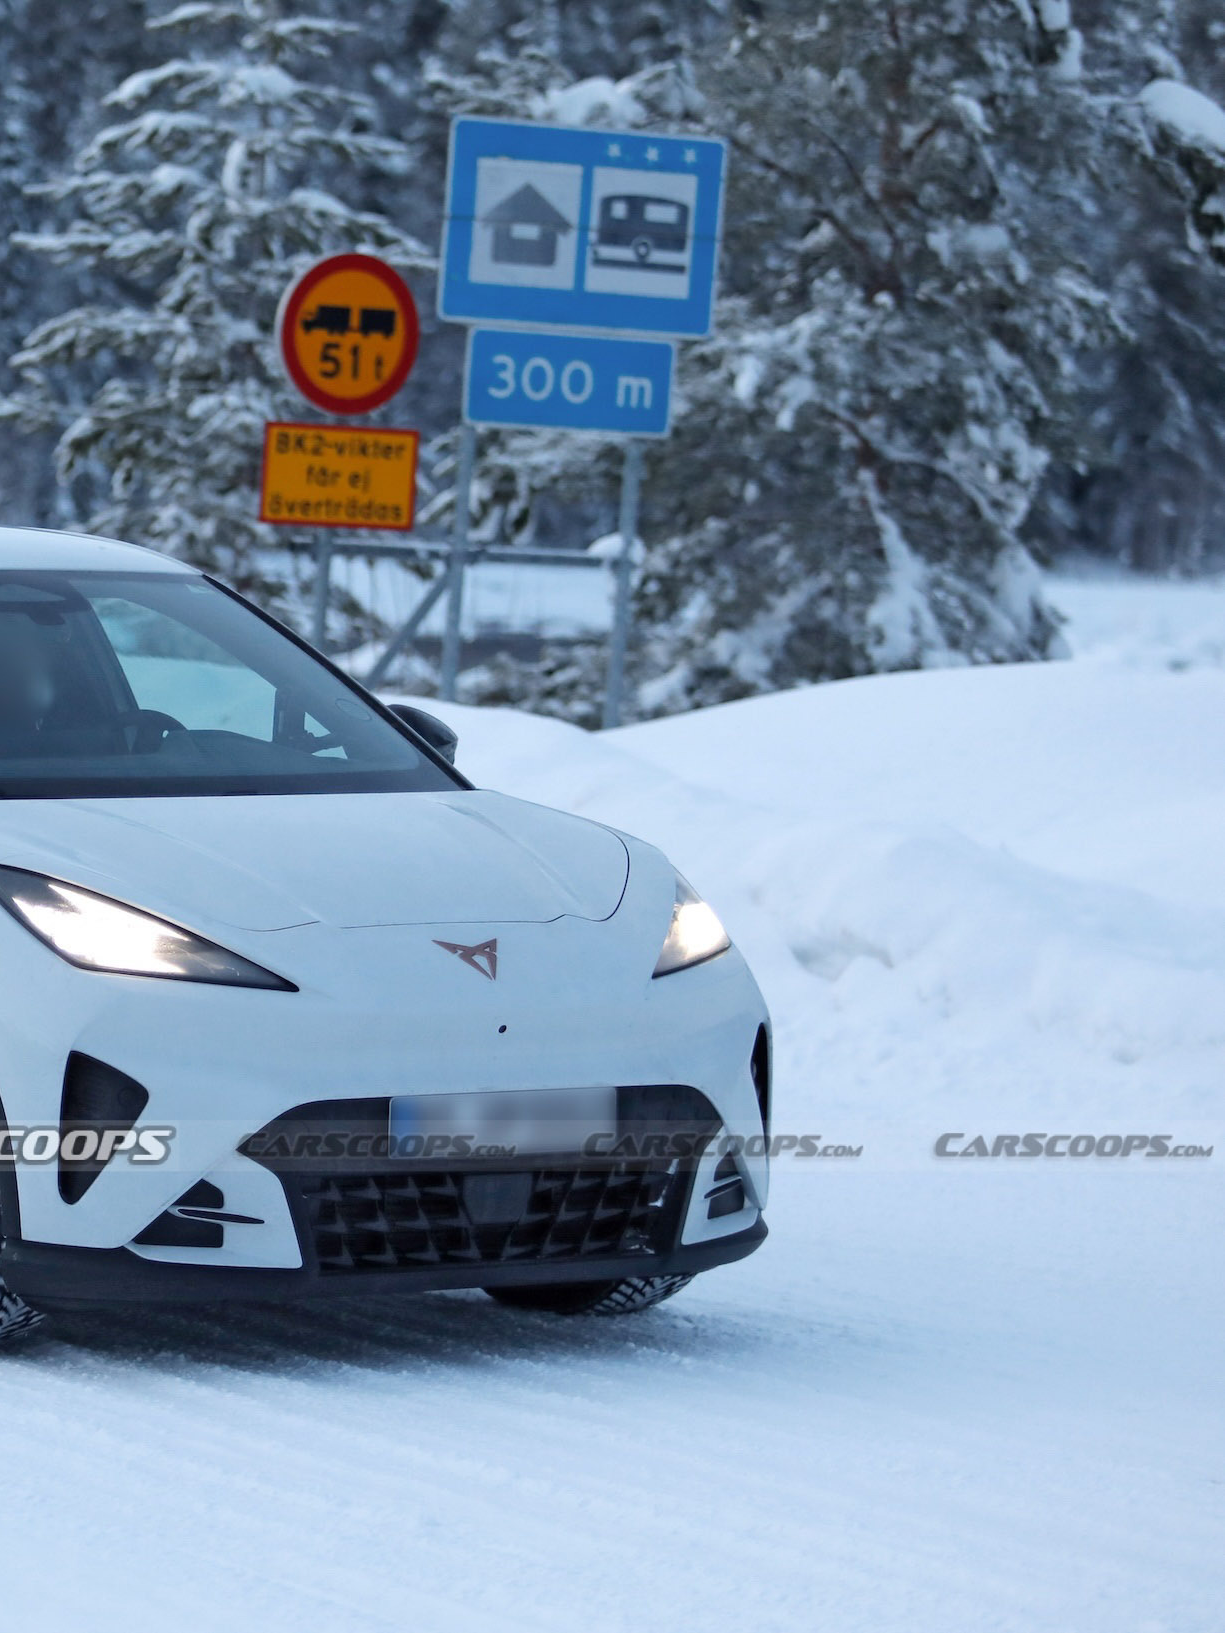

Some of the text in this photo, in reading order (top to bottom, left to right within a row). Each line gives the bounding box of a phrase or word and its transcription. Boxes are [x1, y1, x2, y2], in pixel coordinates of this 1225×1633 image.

[319, 342, 384, 382] 51 t
[488, 354, 653, 410] 300 m
[276, 431, 406, 460] BK2-vikter
[347, 467, 372, 494] ej
